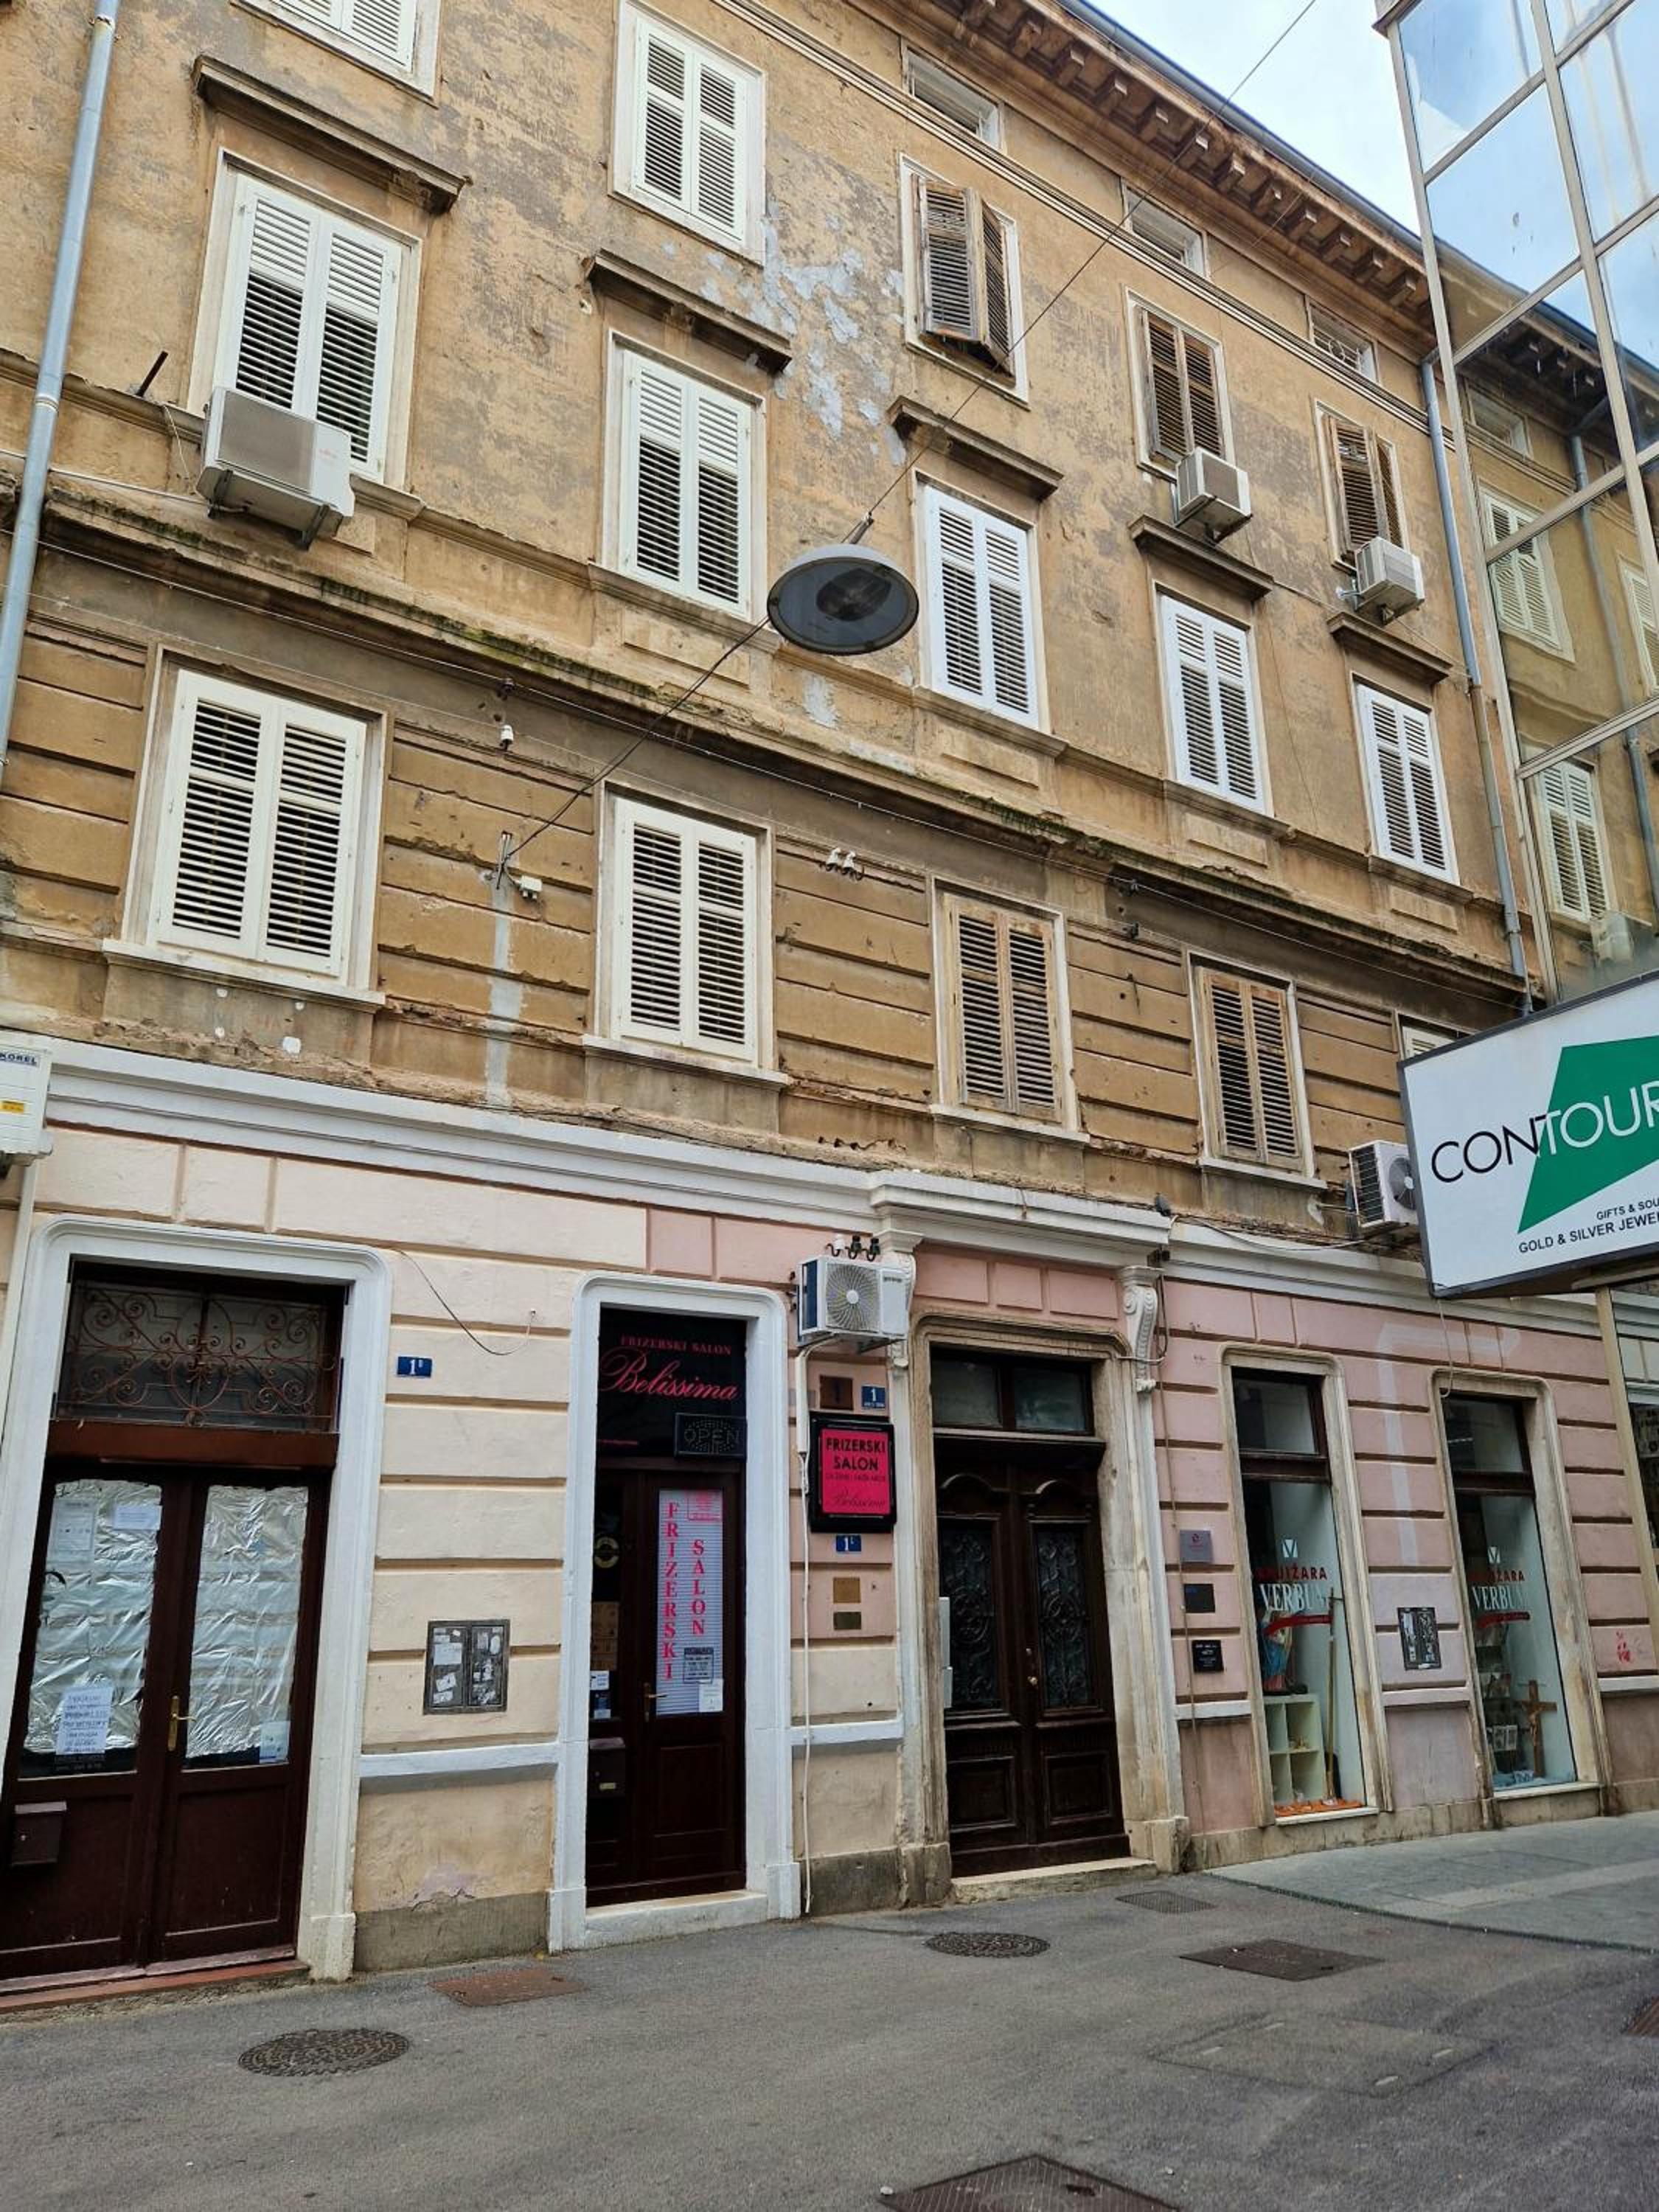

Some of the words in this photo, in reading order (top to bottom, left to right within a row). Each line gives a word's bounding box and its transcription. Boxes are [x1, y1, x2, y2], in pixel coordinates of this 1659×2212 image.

[1596, 1206, 1626, 1220] GIFTS
[1628, 1204, 1635, 1213] &
[1518, 1237, 1554, 1253] GOLD
[1557, 1234, 1566, 1245] &
[1570, 1222, 1615, 1242] SILVER
[1618, 1211, 1659, 1231] JEWE
[621, 1335, 686, 1352] FRIZERSKI
[692, 1342, 731, 1356] SALON
[599, 1346, 741, 1400] Belissima
[871, 1388, 877, 1402] 1
[826, 1437, 886, 1453] FRIZERSKI
[833, 1455, 878, 1471] SALON
[663, 1502, 679, 1680] FRIZERSKI
[691, 1539, 706, 1635] SALON
